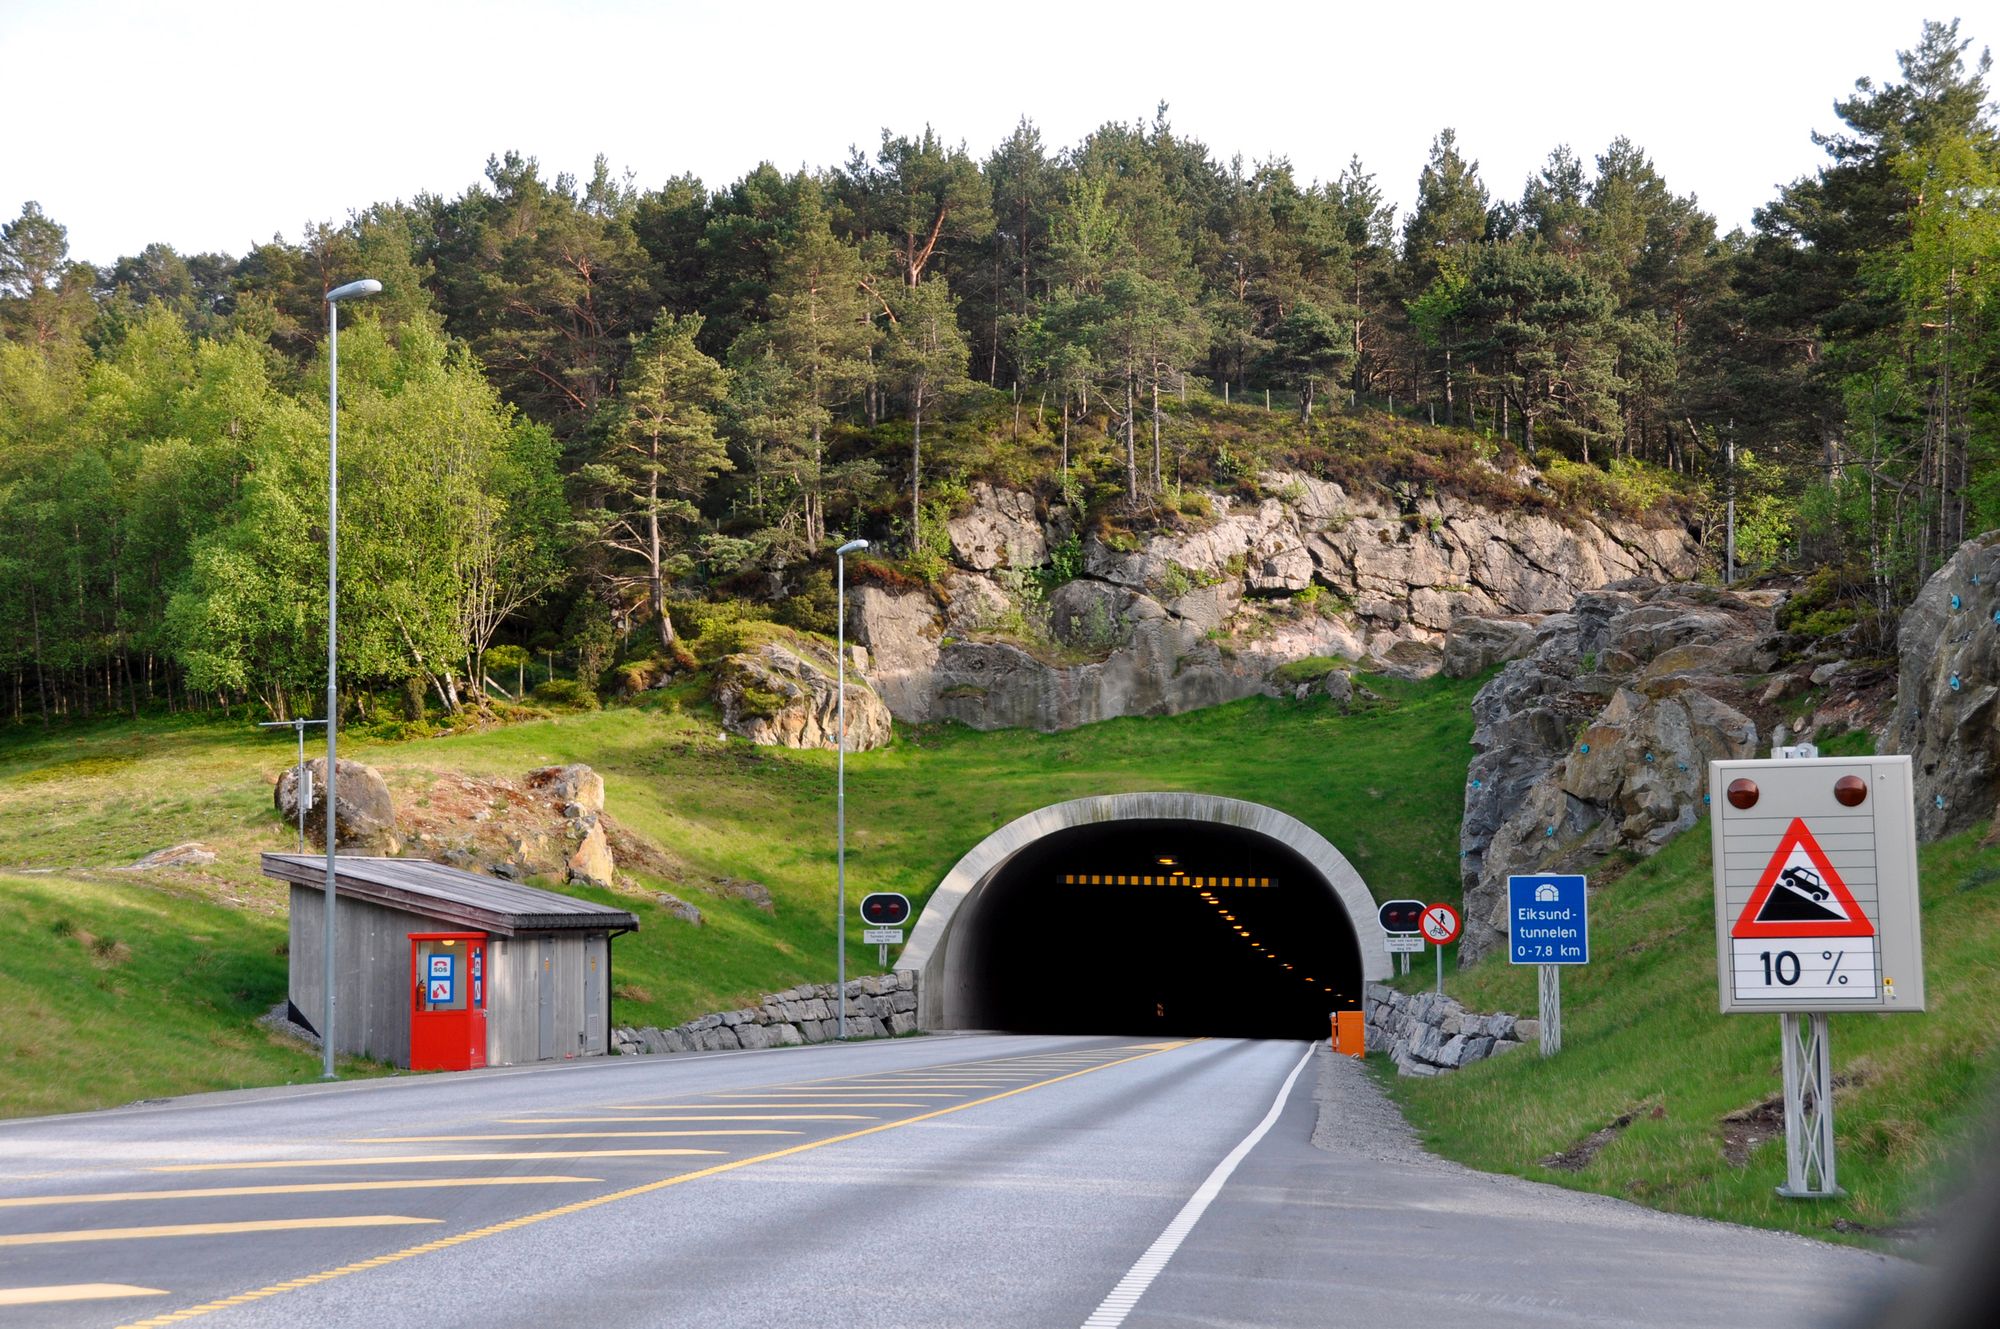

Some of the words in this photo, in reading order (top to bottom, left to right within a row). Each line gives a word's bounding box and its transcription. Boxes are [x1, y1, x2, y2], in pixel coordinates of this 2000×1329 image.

[1518, 908, 1577, 920] Eiksund-
[1520, 926, 1577, 938] tunnelen
[1560, 945, 1580, 956] km
[1760, 950, 1801, 986] 10
[1822, 950, 1848, 985] %
